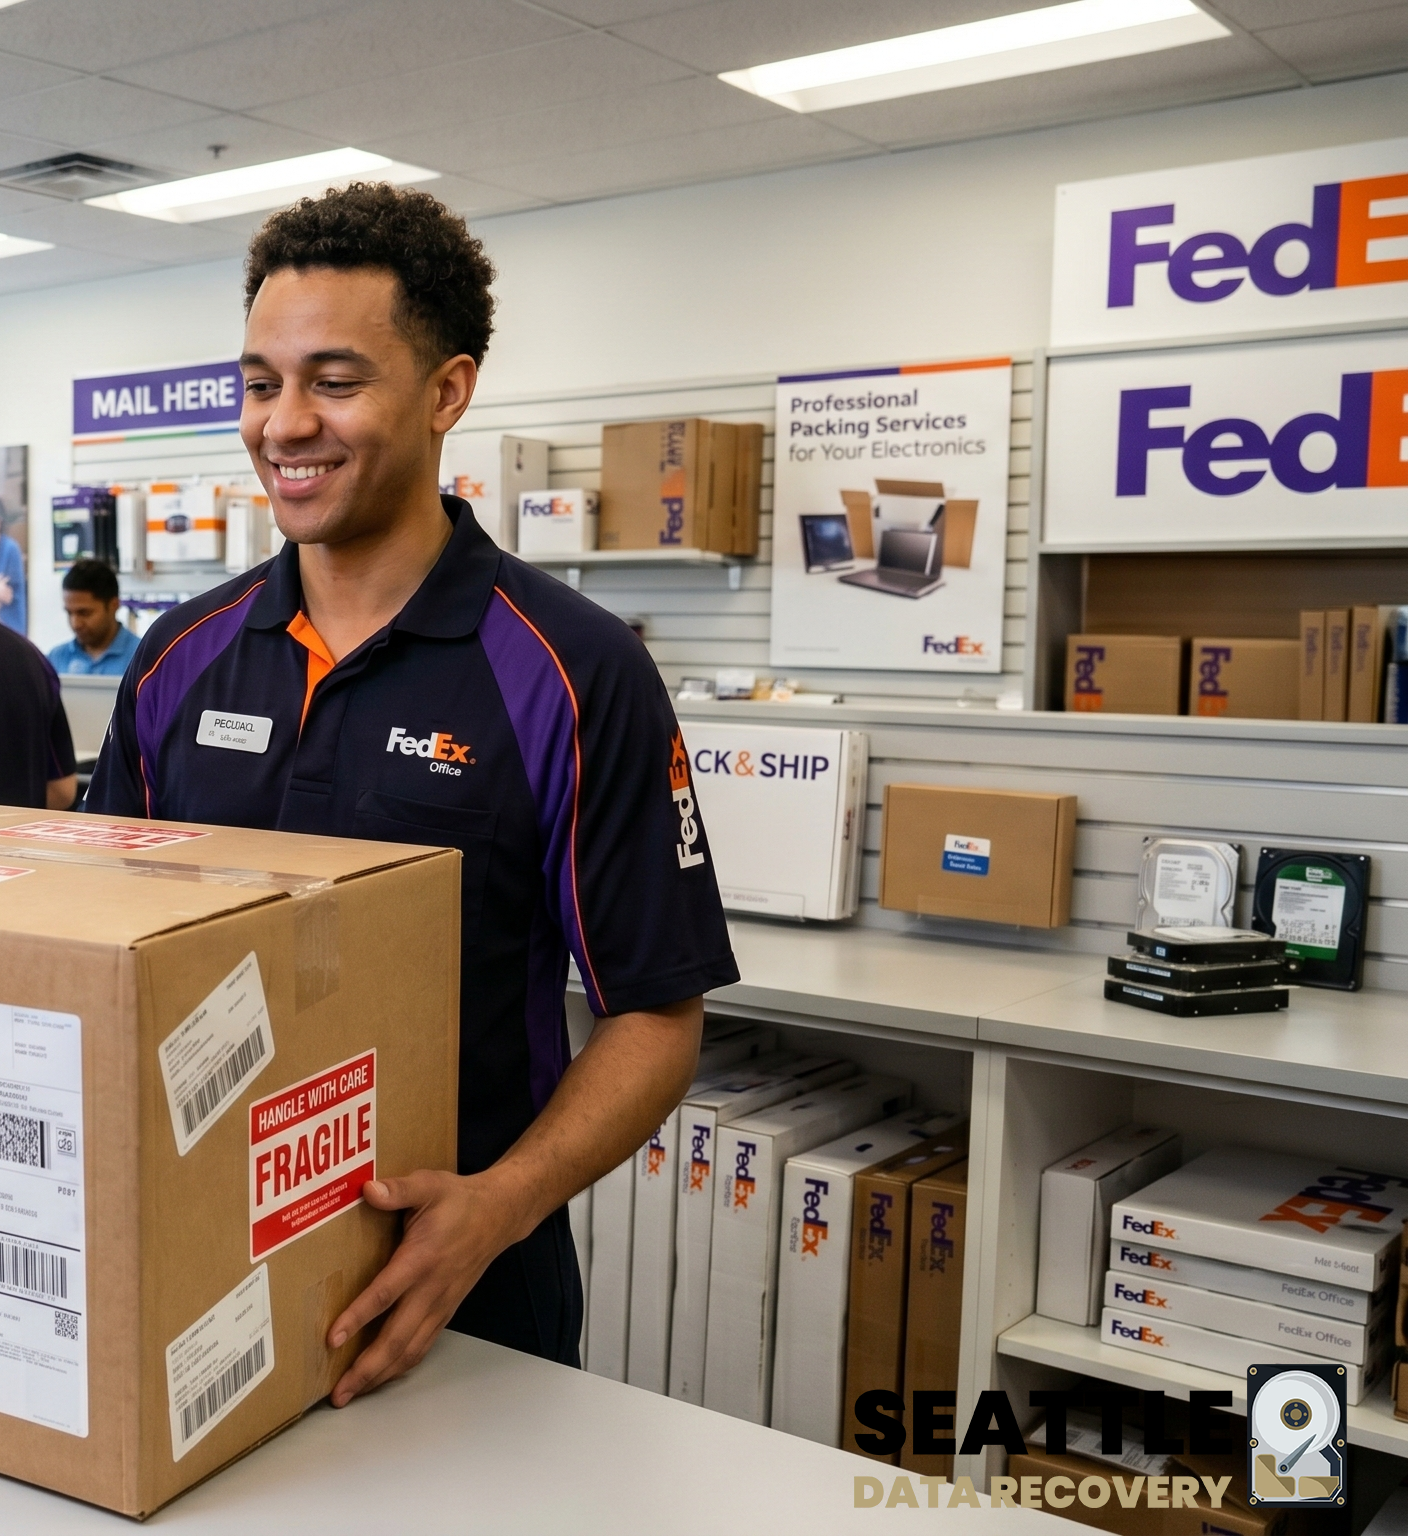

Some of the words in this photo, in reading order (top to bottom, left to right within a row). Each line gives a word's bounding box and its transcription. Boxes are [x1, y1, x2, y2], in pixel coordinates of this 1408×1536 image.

[1107, 173, 1408, 309] FedE
[92, 384, 159, 420] MAIL
[163, 376, 236, 412] HERE
[790, 389, 918, 414] Professional
[790, 417, 870, 439] Packing
[875, 412, 967, 434] Services
[1115, 368, 1408, 498] FedE
[788, 443, 816, 462] for
[820, 441, 866, 461] Your
[871, 437, 986, 459] Electronics
[522, 496, 574, 517] FedEx
[922, 634, 985, 656] FedEx
[386, 727, 471, 764] FedEx
[429, 761, 462, 777] Office
[258, 1093, 305, 1134] HANGLE
[307, 1078, 338, 1109] WITH
[339, 1063, 369, 1095] CARE
[255, 1102, 372, 1208] FRAGILE
[689, 1124, 711, 1191] FedEx
[733, 1140, 757, 1210] FedEx
[801, 1177, 829, 1257] FedEx
[868, 1191, 893, 1262] FedEx
[1122, 1214, 1176, 1240] FedEx
[929, 1201, 955, 1274] FedEx
[1120, 1246, 1173, 1272] FedEx
[1114, 1283, 1169, 1310] FedEx
[1111, 1319, 1165, 1346] FedEx
[1315, 1331, 1352, 1348] Office
